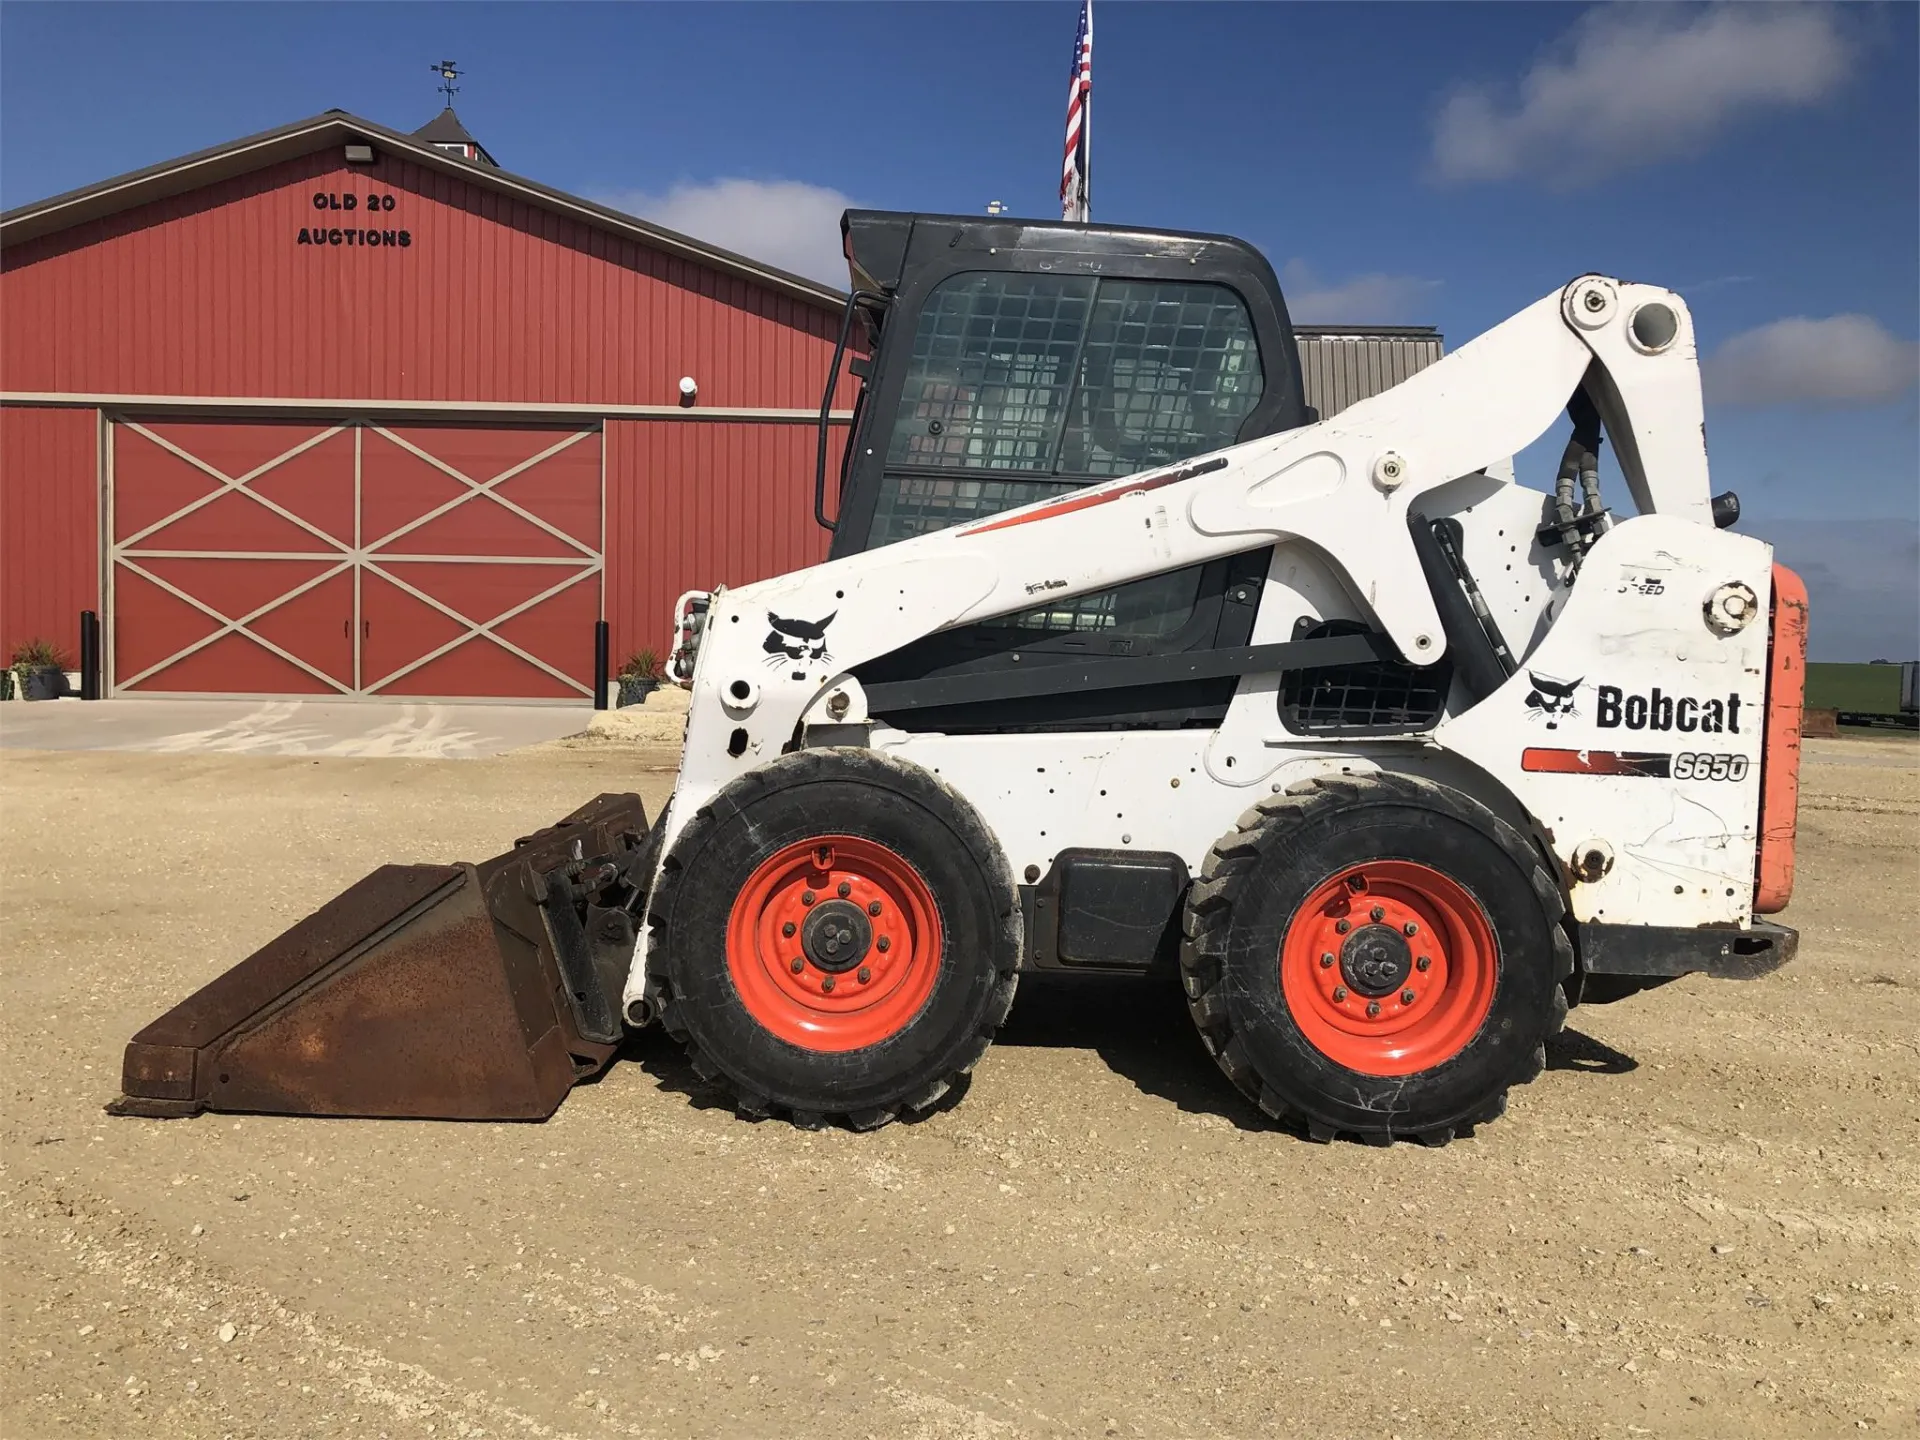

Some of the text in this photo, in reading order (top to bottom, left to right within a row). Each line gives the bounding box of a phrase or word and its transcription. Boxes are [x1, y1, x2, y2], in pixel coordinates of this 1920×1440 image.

[313, 192, 396, 212] OLD 20
[297, 228, 412, 248] AUCTIONS
[1596, 685, 1742, 734] Bobcat
[1674, 752, 1750, 782] S650
